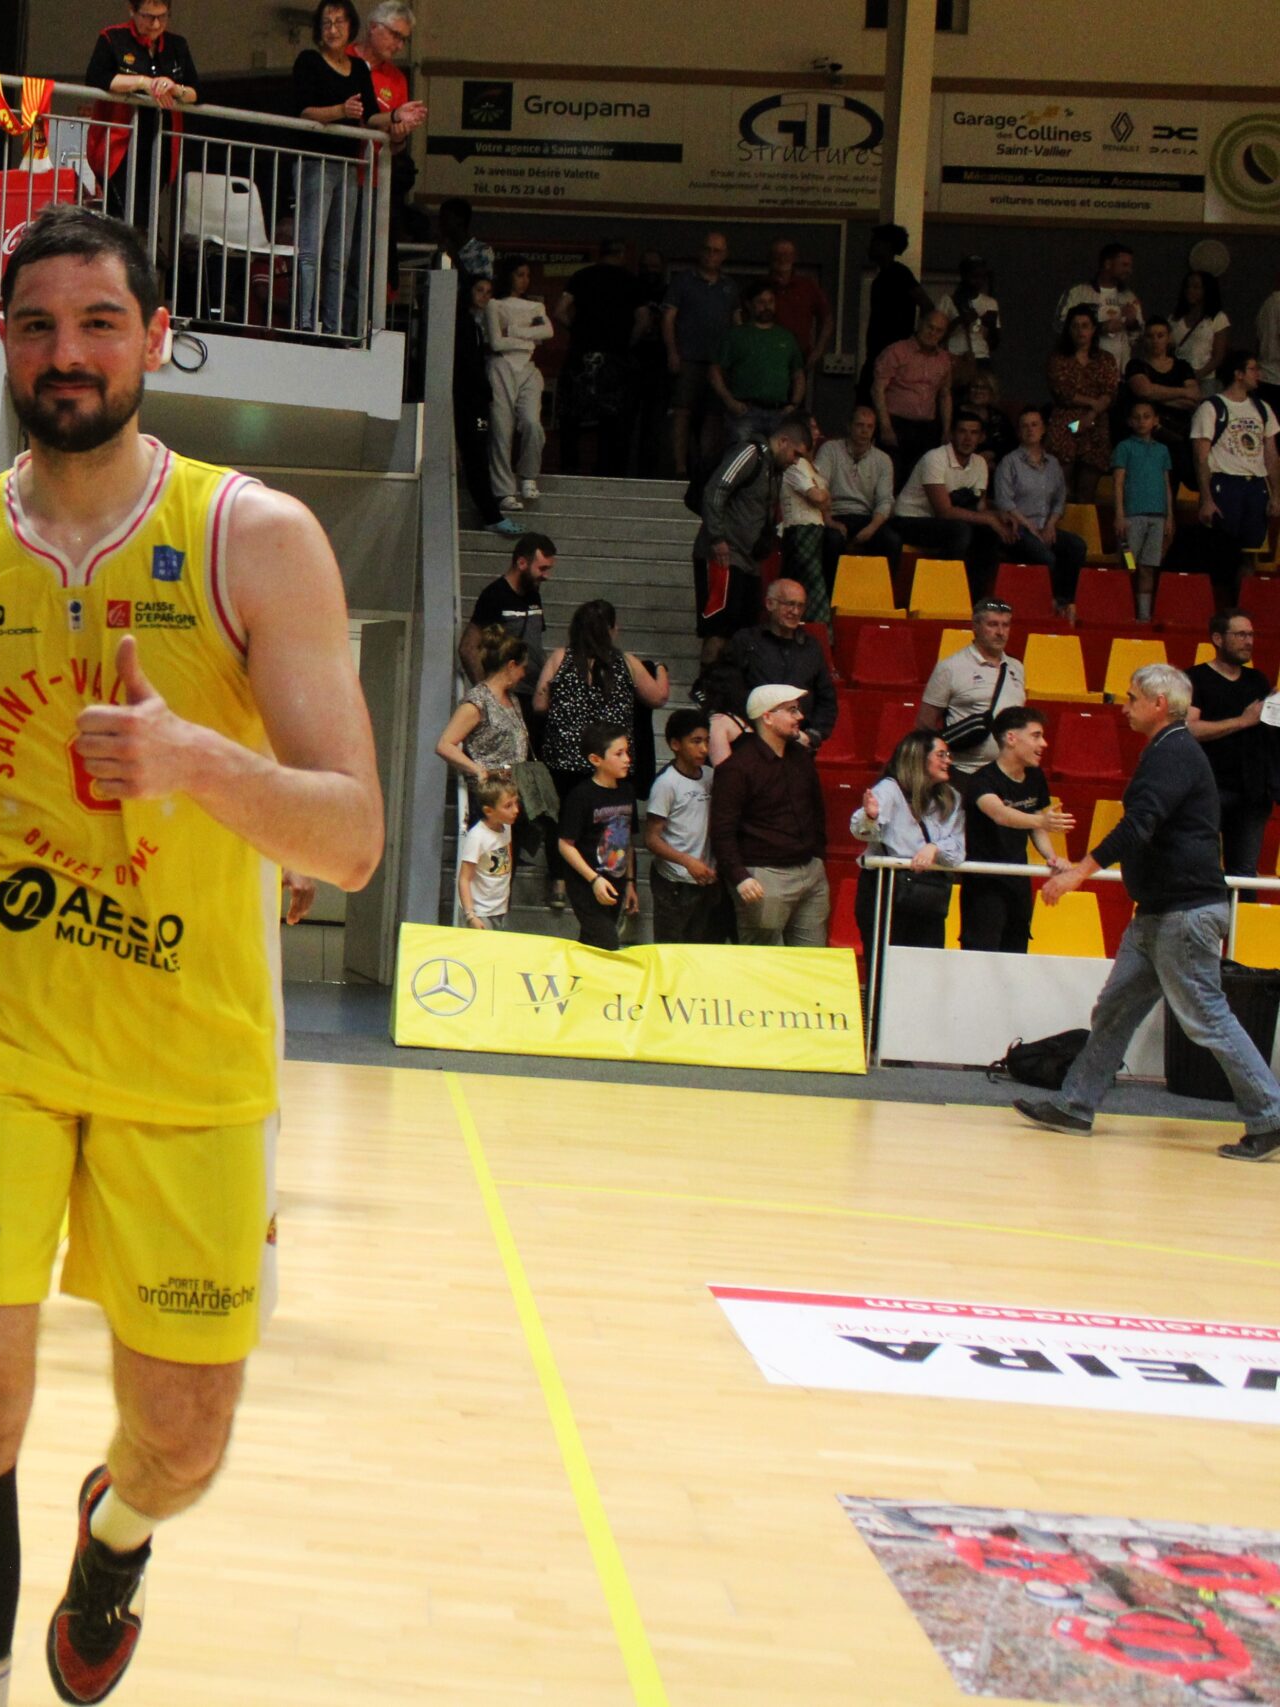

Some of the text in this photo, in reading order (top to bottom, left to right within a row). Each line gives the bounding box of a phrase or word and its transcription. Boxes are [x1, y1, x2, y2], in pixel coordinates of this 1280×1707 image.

[524, 95, 651, 120] Groupama
[953, 111, 1018, 129] Garage
[1015, 124, 1093, 142] Collines
[475, 142, 503, 152] Votre
[505, 145, 541, 157] agence
[551, 145, 614, 157] Saint-Vallier
[996, 144, 1073, 158] Saint-Vallier
[474, 166, 485, 176] 24
[488, 168, 526, 177] avenue
[563, 168, 601, 179] Valette
[1036, 173, 1101, 186] Carrosserie
[494, 184, 507, 194] 04
[990, 195, 1151, 211] voitures neuves et occasions
[135, 600, 177, 613] CAISSE
[604, 995, 644, 1022] de
[659, 994, 850, 1031] Willermin
[168, 1276, 200, 1290] PORTE
